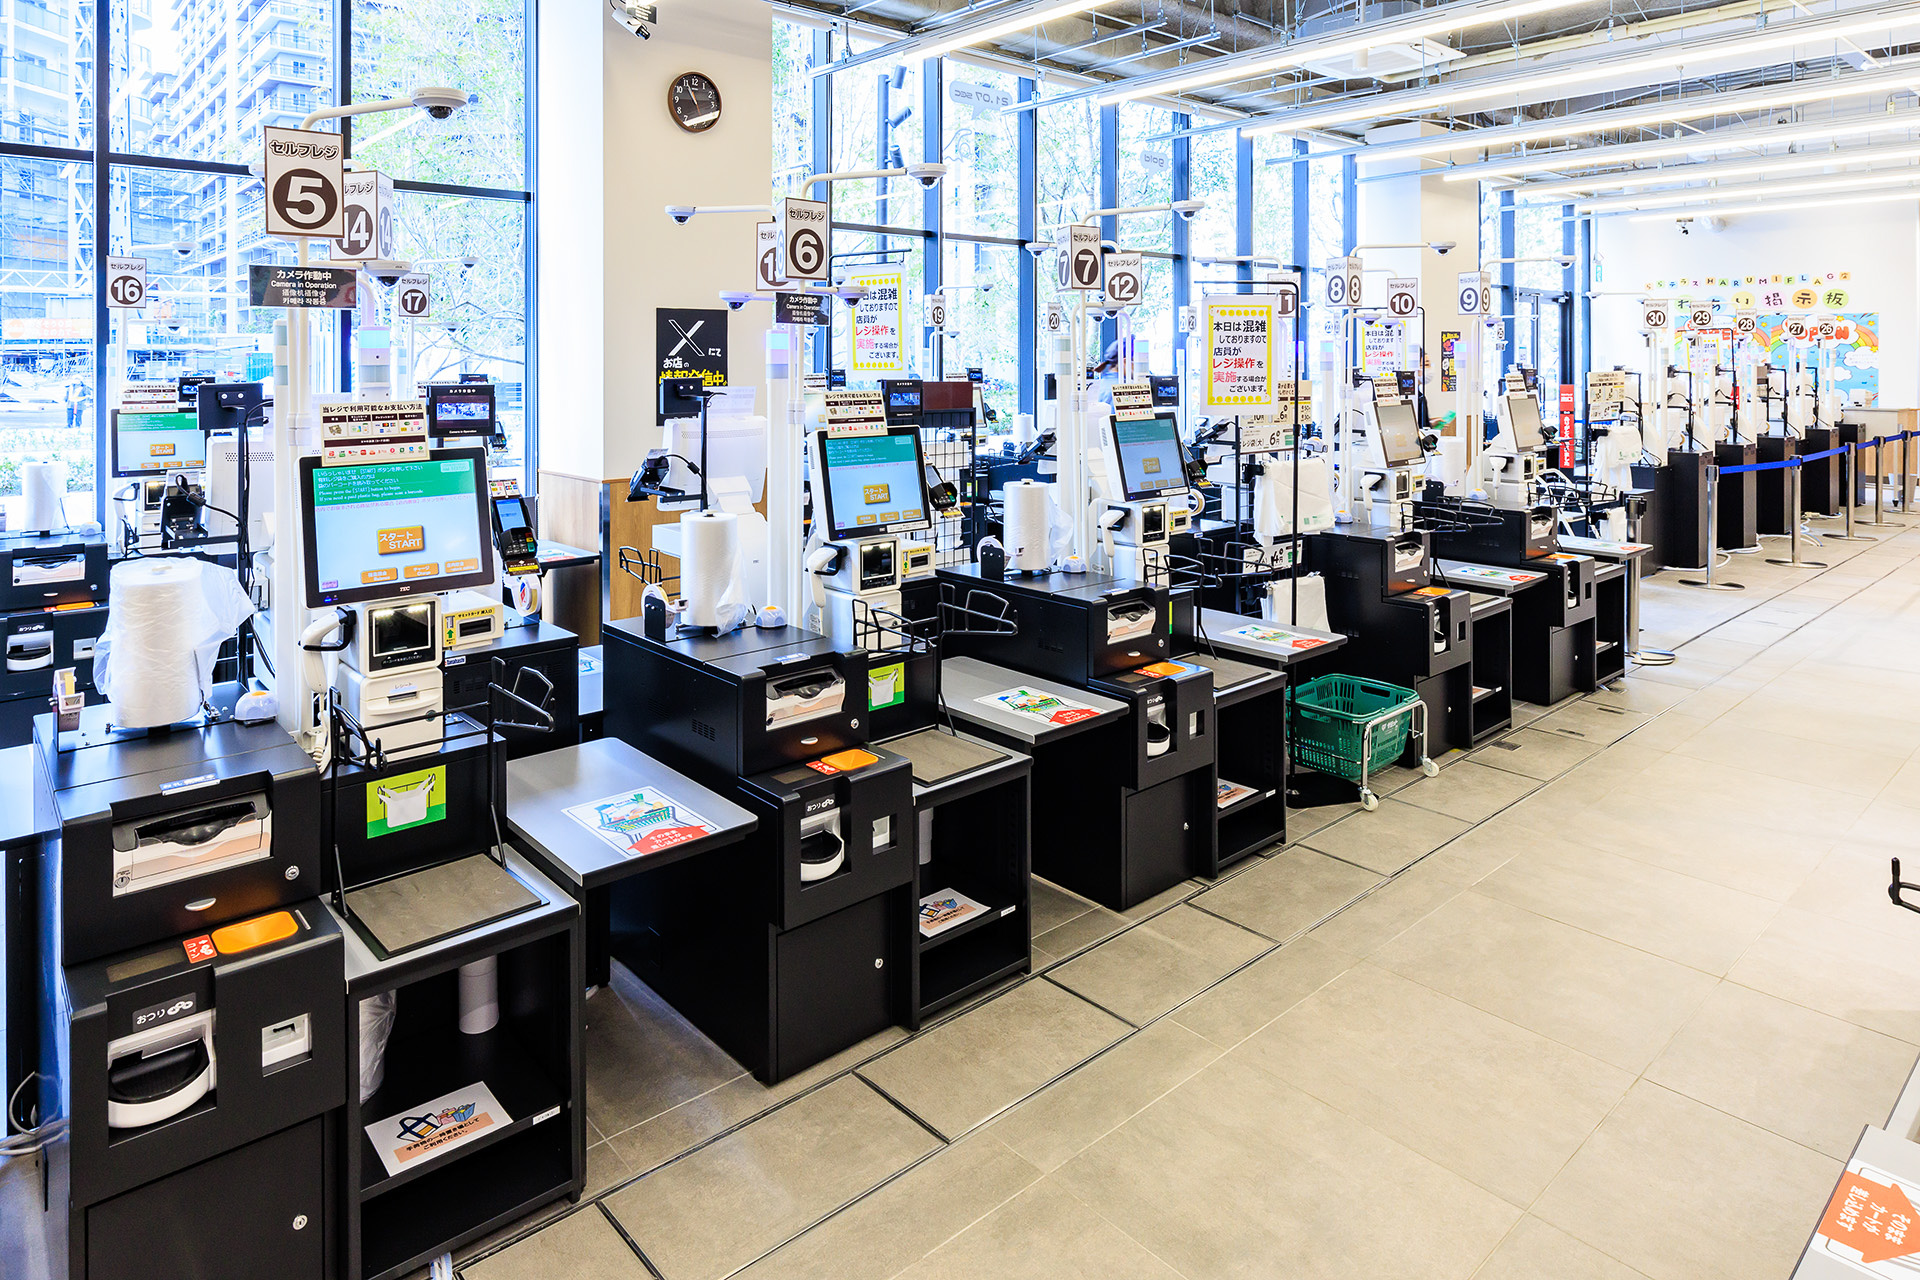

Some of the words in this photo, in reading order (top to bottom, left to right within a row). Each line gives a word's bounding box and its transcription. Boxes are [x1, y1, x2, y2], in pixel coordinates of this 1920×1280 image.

[691, 78, 699, 86] 12
[676, 85, 683, 93] 10
[708, 91, 713, 99] 2
[677, 106, 682, 114] 8
[710, 101, 715, 109] 3
[269, 140, 340, 160] セルフレジ
[285, 175, 327, 225] 5
[789, 207, 825, 222] セルフレジ
[342, 210, 370, 250] 14
[380, 211, 392, 252] 14
[1073, 232, 1099, 243] セルフレジ
[795, 233, 819, 271] 6
[110, 263, 144, 271] セルフレジ
[763, 251, 777, 282] 1
[1060, 255, 1068, 284] 7
[1078, 253, 1095, 283] 7
[1107, 259, 1139, 267] セルフレジ
[277, 269, 332, 281] カメラ作動中
[113, 279, 141, 302] 16
[270, 280, 297, 289] Camera
[297, 280, 304, 288] in
[304, 281, 337, 290] Operation
[1110, 275, 1135, 299] 12
[1330, 276, 1344, 302] 8
[1350, 276, 1360, 302] 8
[404, 291, 424, 311] 17
[1391, 294, 1414, 314] 10
[1462, 289, 1476, 311] 9
[1482, 289, 1490, 311] 9
[856, 315, 878, 324] 店員が
[933, 306, 944, 324] 19
[1049, 313, 1060, 329] 20
[1647, 311, 1665, 326] 30
[1694, 311, 1711, 325] 29
[1213, 320, 1267, 332] 本日は混雑
[1739, 319, 1755, 332] 28
[1789, 323, 1804, 336] 27
[1819, 323, 1834, 335] 26
[1219, 335, 1267, 344] しておりますので
[708, 347, 722, 357] にて
[1213, 347, 1242, 356] 店員が
[663, 356, 689, 369] お店の
[1212, 358, 1264, 369] レジ操作を
[1229, 384, 1267, 393] ございます。
[322, 403, 423, 414] 当レジで利用可能なお支払い方法
[863, 487, 884, 496] スタート
[869, 492, 889, 501] START
[379, 531, 413, 543] スタート
[389, 538, 422, 549] START
[136, 1008, 166, 1025] おつり
[1862, 1201, 1889, 1237] カートが
